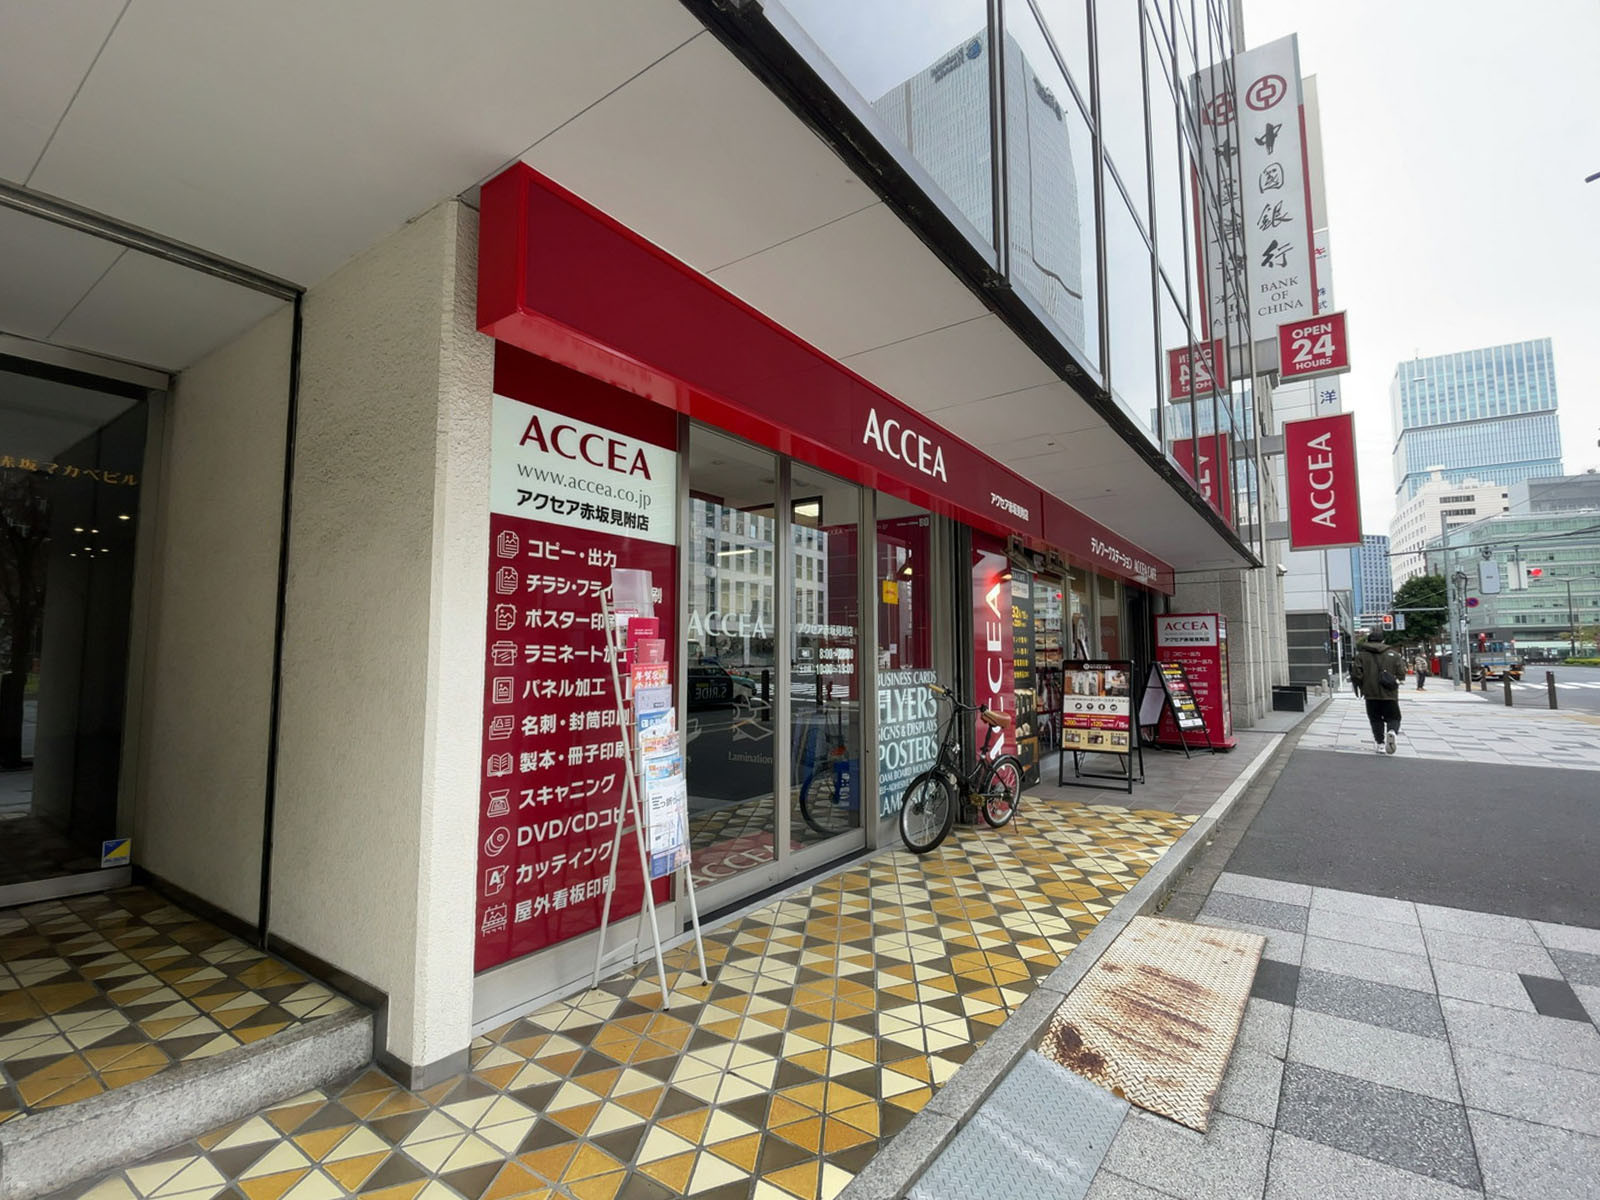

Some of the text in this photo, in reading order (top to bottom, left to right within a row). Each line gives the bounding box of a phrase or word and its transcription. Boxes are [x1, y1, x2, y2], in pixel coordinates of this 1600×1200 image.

[1260, 275, 1299, 294] BANK
[1271, 289, 1290, 302] OF
[1257, 299, 1304, 317] CHINA
[1291, 321, 1332, 340] OPEN
[1291, 334, 1336, 364] 24
[1295, 356, 1332, 371] HOURS
[518, 414, 653, 481] ACCEA
[862, 407, 948, 484] ACCEA
[516, 463, 652, 511] www.accea.co.jp
[1307, 431, 1337, 528] ACCEA
[516, 488, 650, 532] アクセア赤坂見附店
[527, 538, 618, 569] コピー・出力
[686, 609, 767, 640] ACCEA
[1164, 620, 1209, 632] ACCEA
[521, 677, 607, 700] パネル加工
[912, 670, 937, 684] CARDS
[878, 686, 938, 726] FLYERS
[900, 725, 907, 737] &
[907, 719, 938, 737] DISPLAYS
[727, 751, 773, 765] Lamination
[518, 773, 616, 810] スキャニング
[515, 840, 615, 886] カッティング
